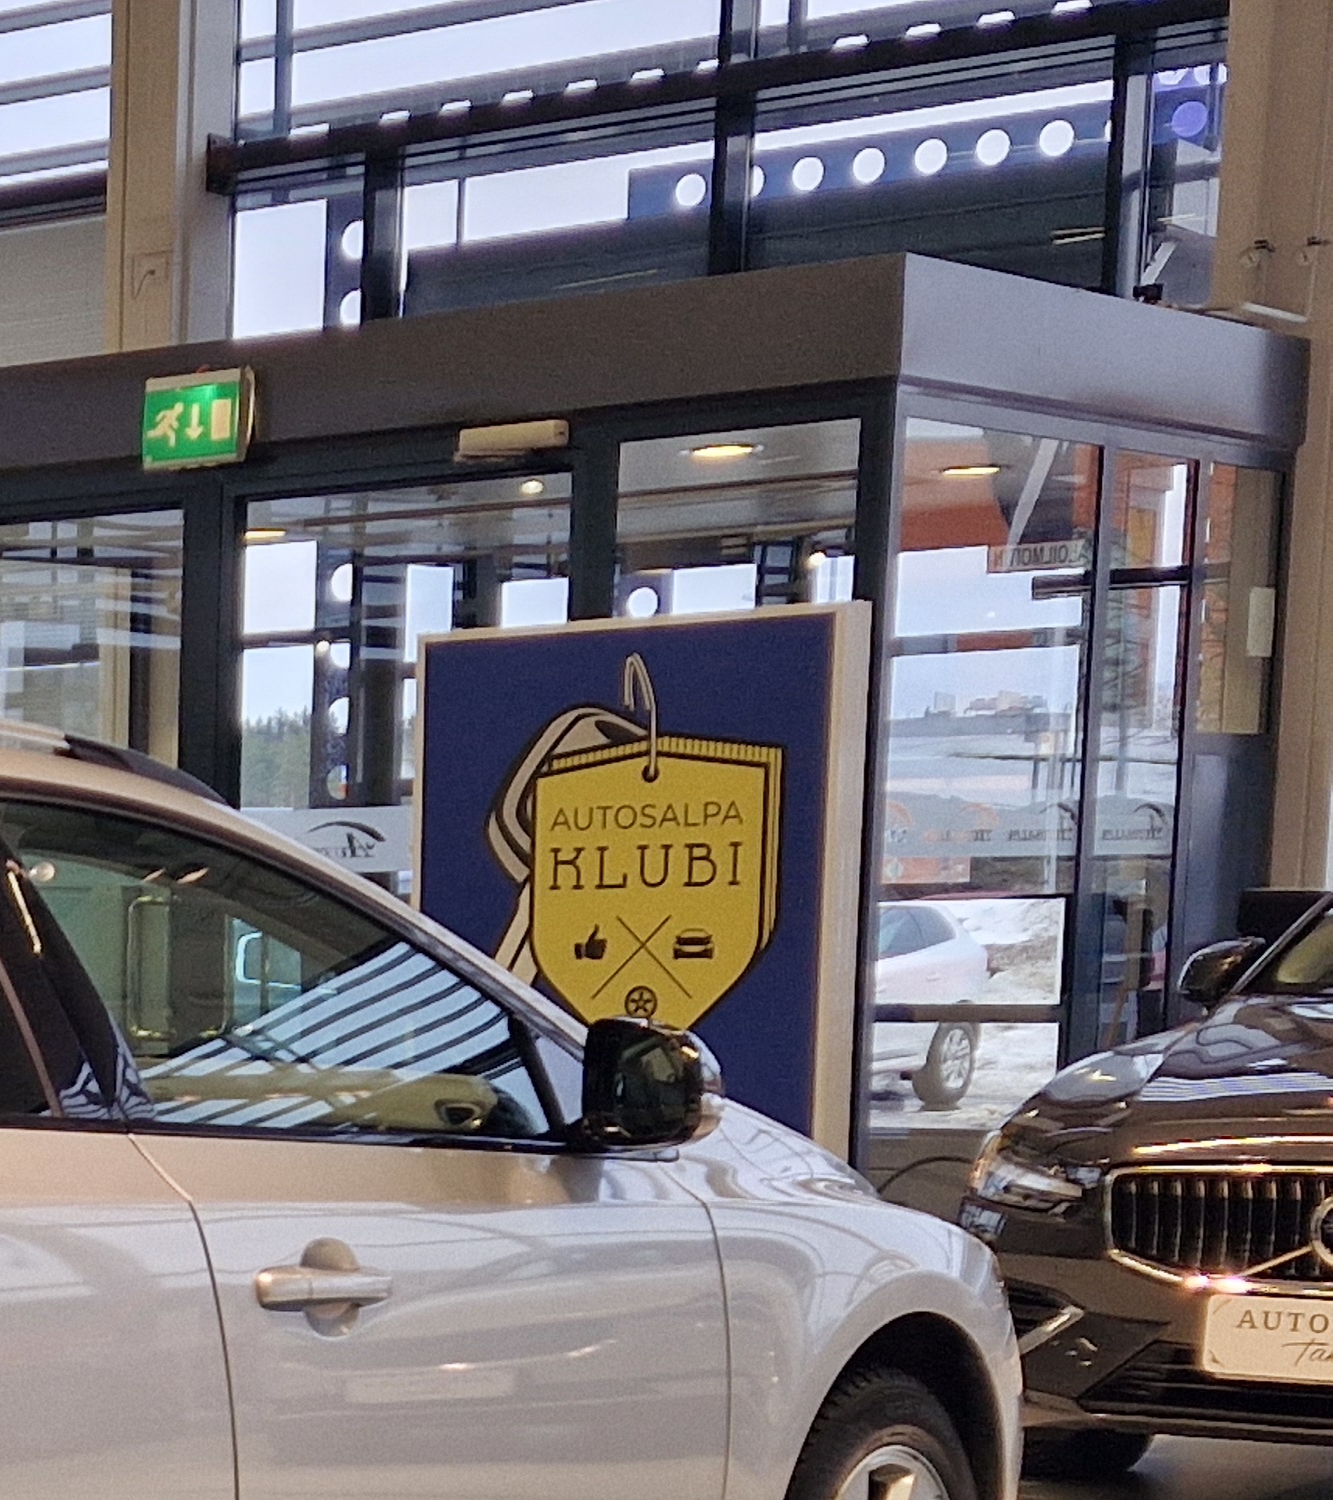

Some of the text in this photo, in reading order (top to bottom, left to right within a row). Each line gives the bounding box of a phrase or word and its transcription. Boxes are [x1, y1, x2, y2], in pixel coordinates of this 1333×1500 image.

[550, 800, 745, 832] AUTOSALPA
[548, 840, 743, 890] KLUBI
[1281, 1338, 1333, 1367] Ta
